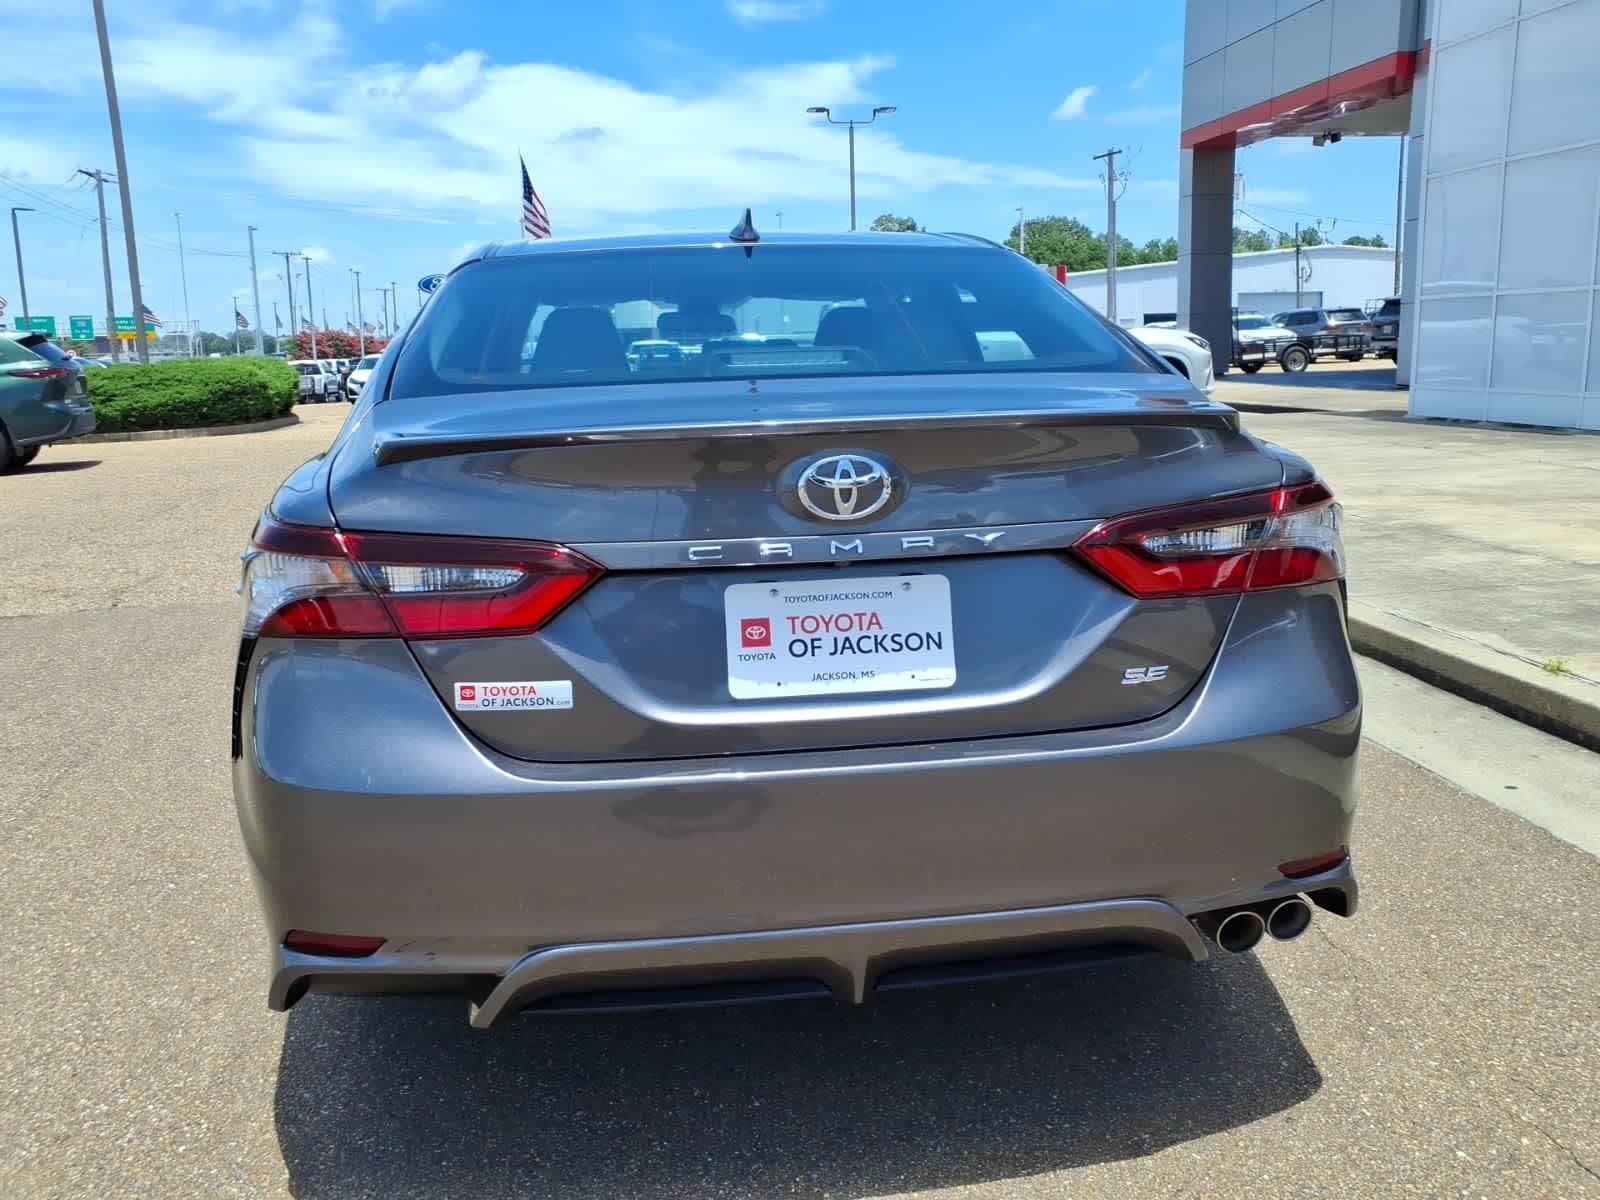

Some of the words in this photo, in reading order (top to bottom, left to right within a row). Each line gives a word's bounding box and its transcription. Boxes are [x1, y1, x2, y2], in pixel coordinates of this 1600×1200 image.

[687, 531, 1007, 561] CAMRY
[784, 591, 894, 604] TOYOTAOFJACKSON.COM
[786, 611, 883, 635] TOYOTA
[788, 637, 823, 659] OF
[829, 631, 943, 656] JACKSON
[738, 652, 777, 662] TOYOTA
[861, 670, 876, 679] MS
[1121, 665, 1169, 684] SE
[481, 685, 537, 697] TOYOTA
[481, 698, 497, 708] OF
[500, 697, 554, 707] JACKSON
